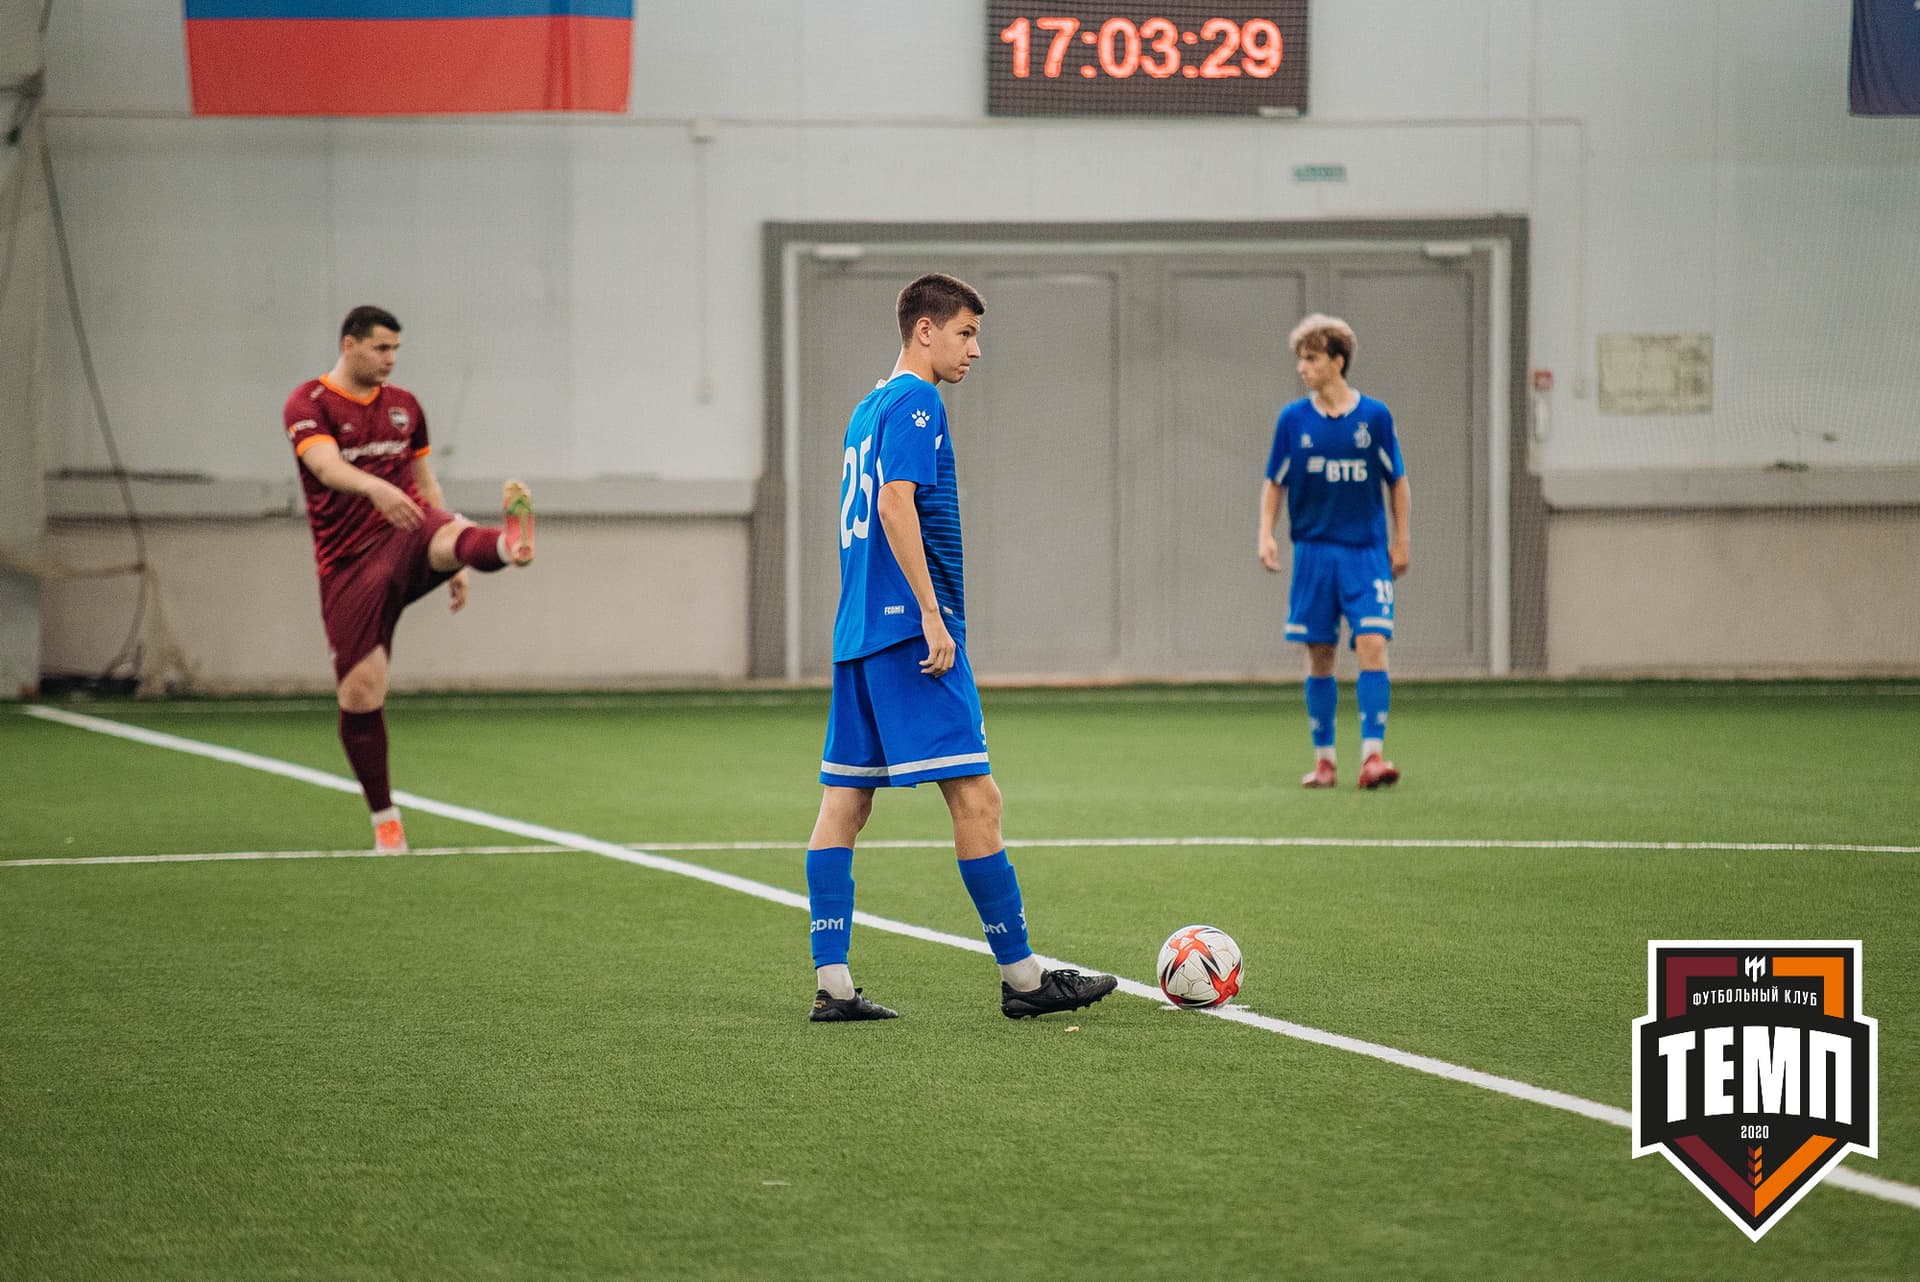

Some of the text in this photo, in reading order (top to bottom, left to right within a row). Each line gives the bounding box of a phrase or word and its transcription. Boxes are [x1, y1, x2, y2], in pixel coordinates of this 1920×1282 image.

[1000, 17, 1284, 79] 17:03:29
[840, 434, 874, 550] 25
[1325, 458, 1368, 483] ВТБ
